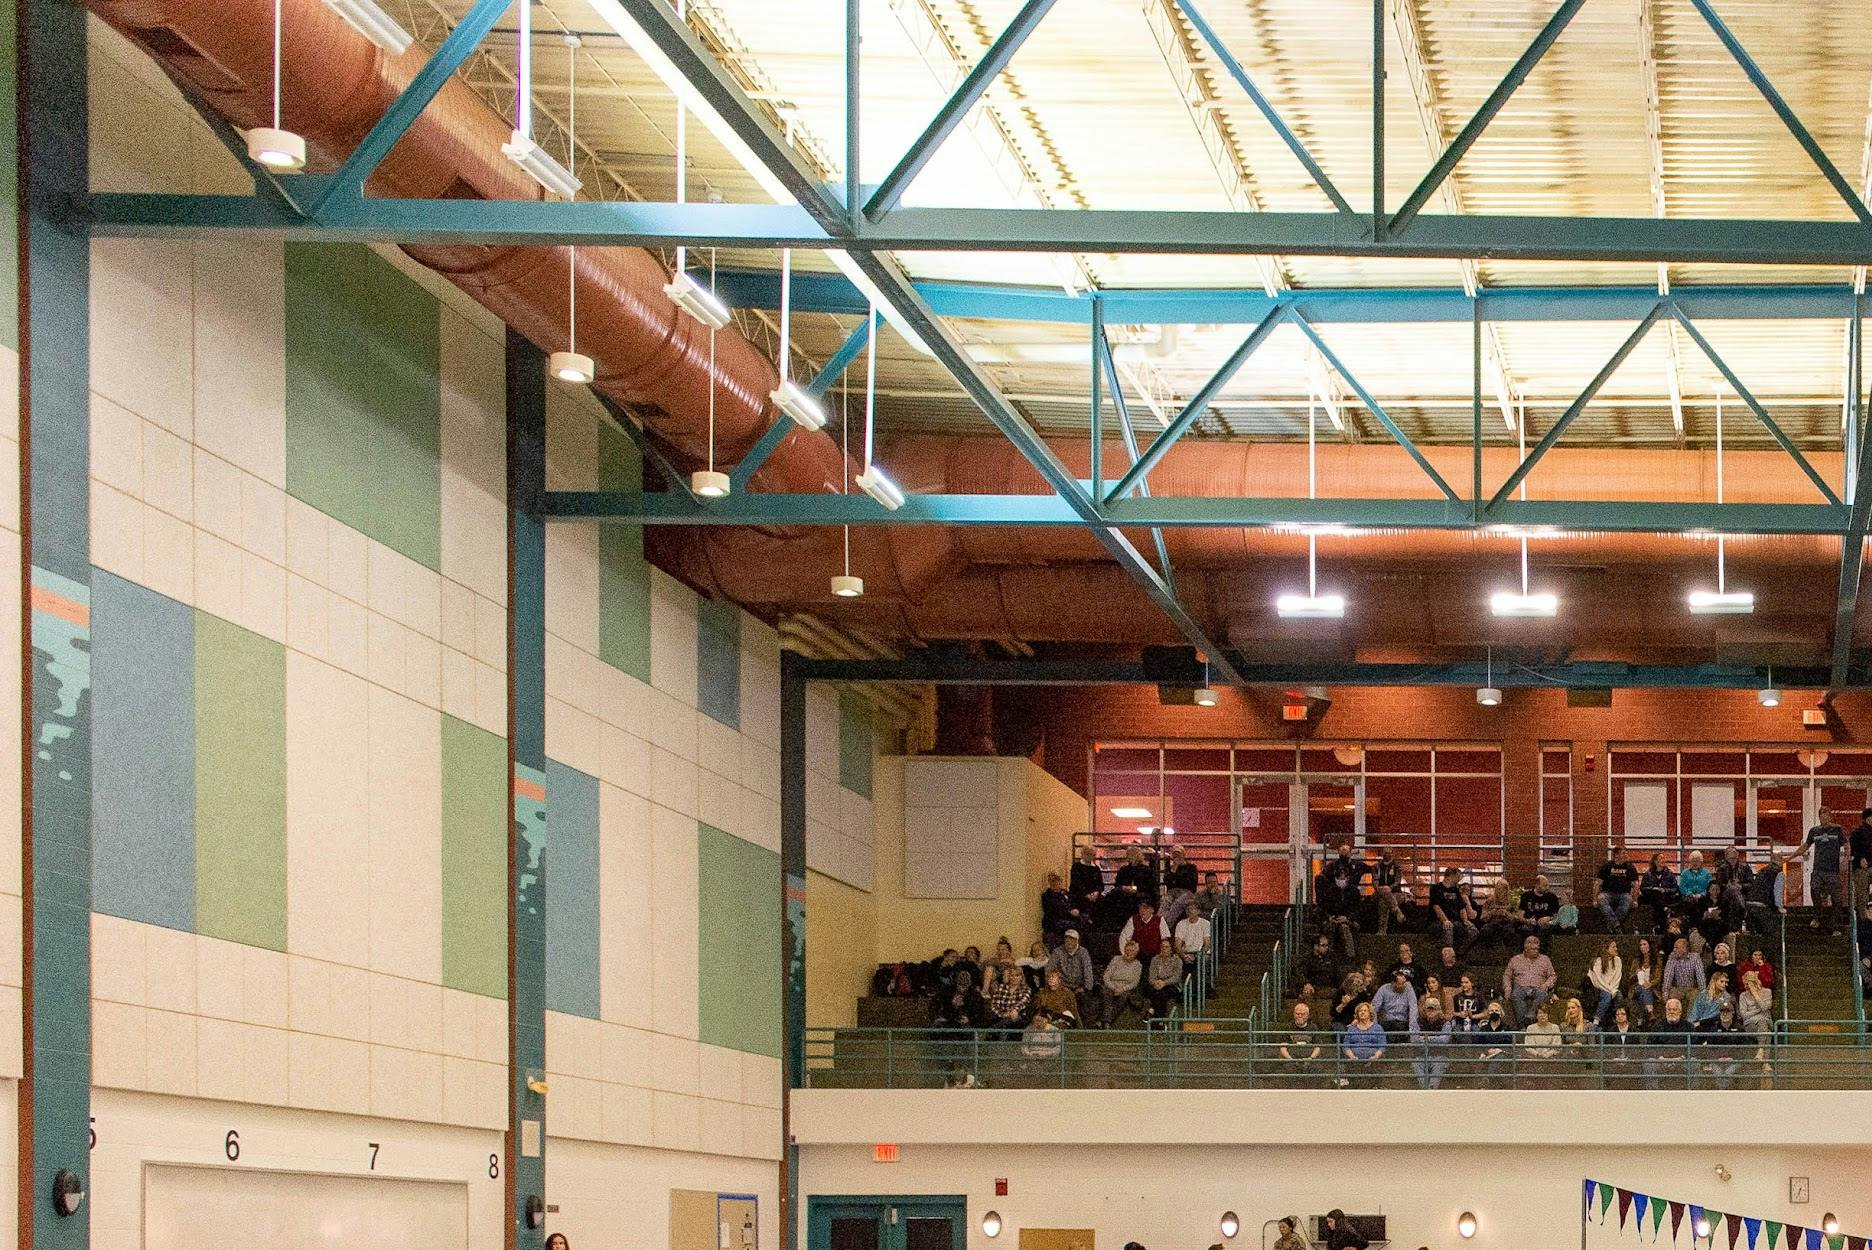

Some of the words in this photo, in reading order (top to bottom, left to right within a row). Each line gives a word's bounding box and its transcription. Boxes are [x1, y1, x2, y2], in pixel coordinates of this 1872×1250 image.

[225, 1129, 241, 1162] 6
[368, 1142, 380, 1171] 7
[488, 1154, 499, 1180] 8
